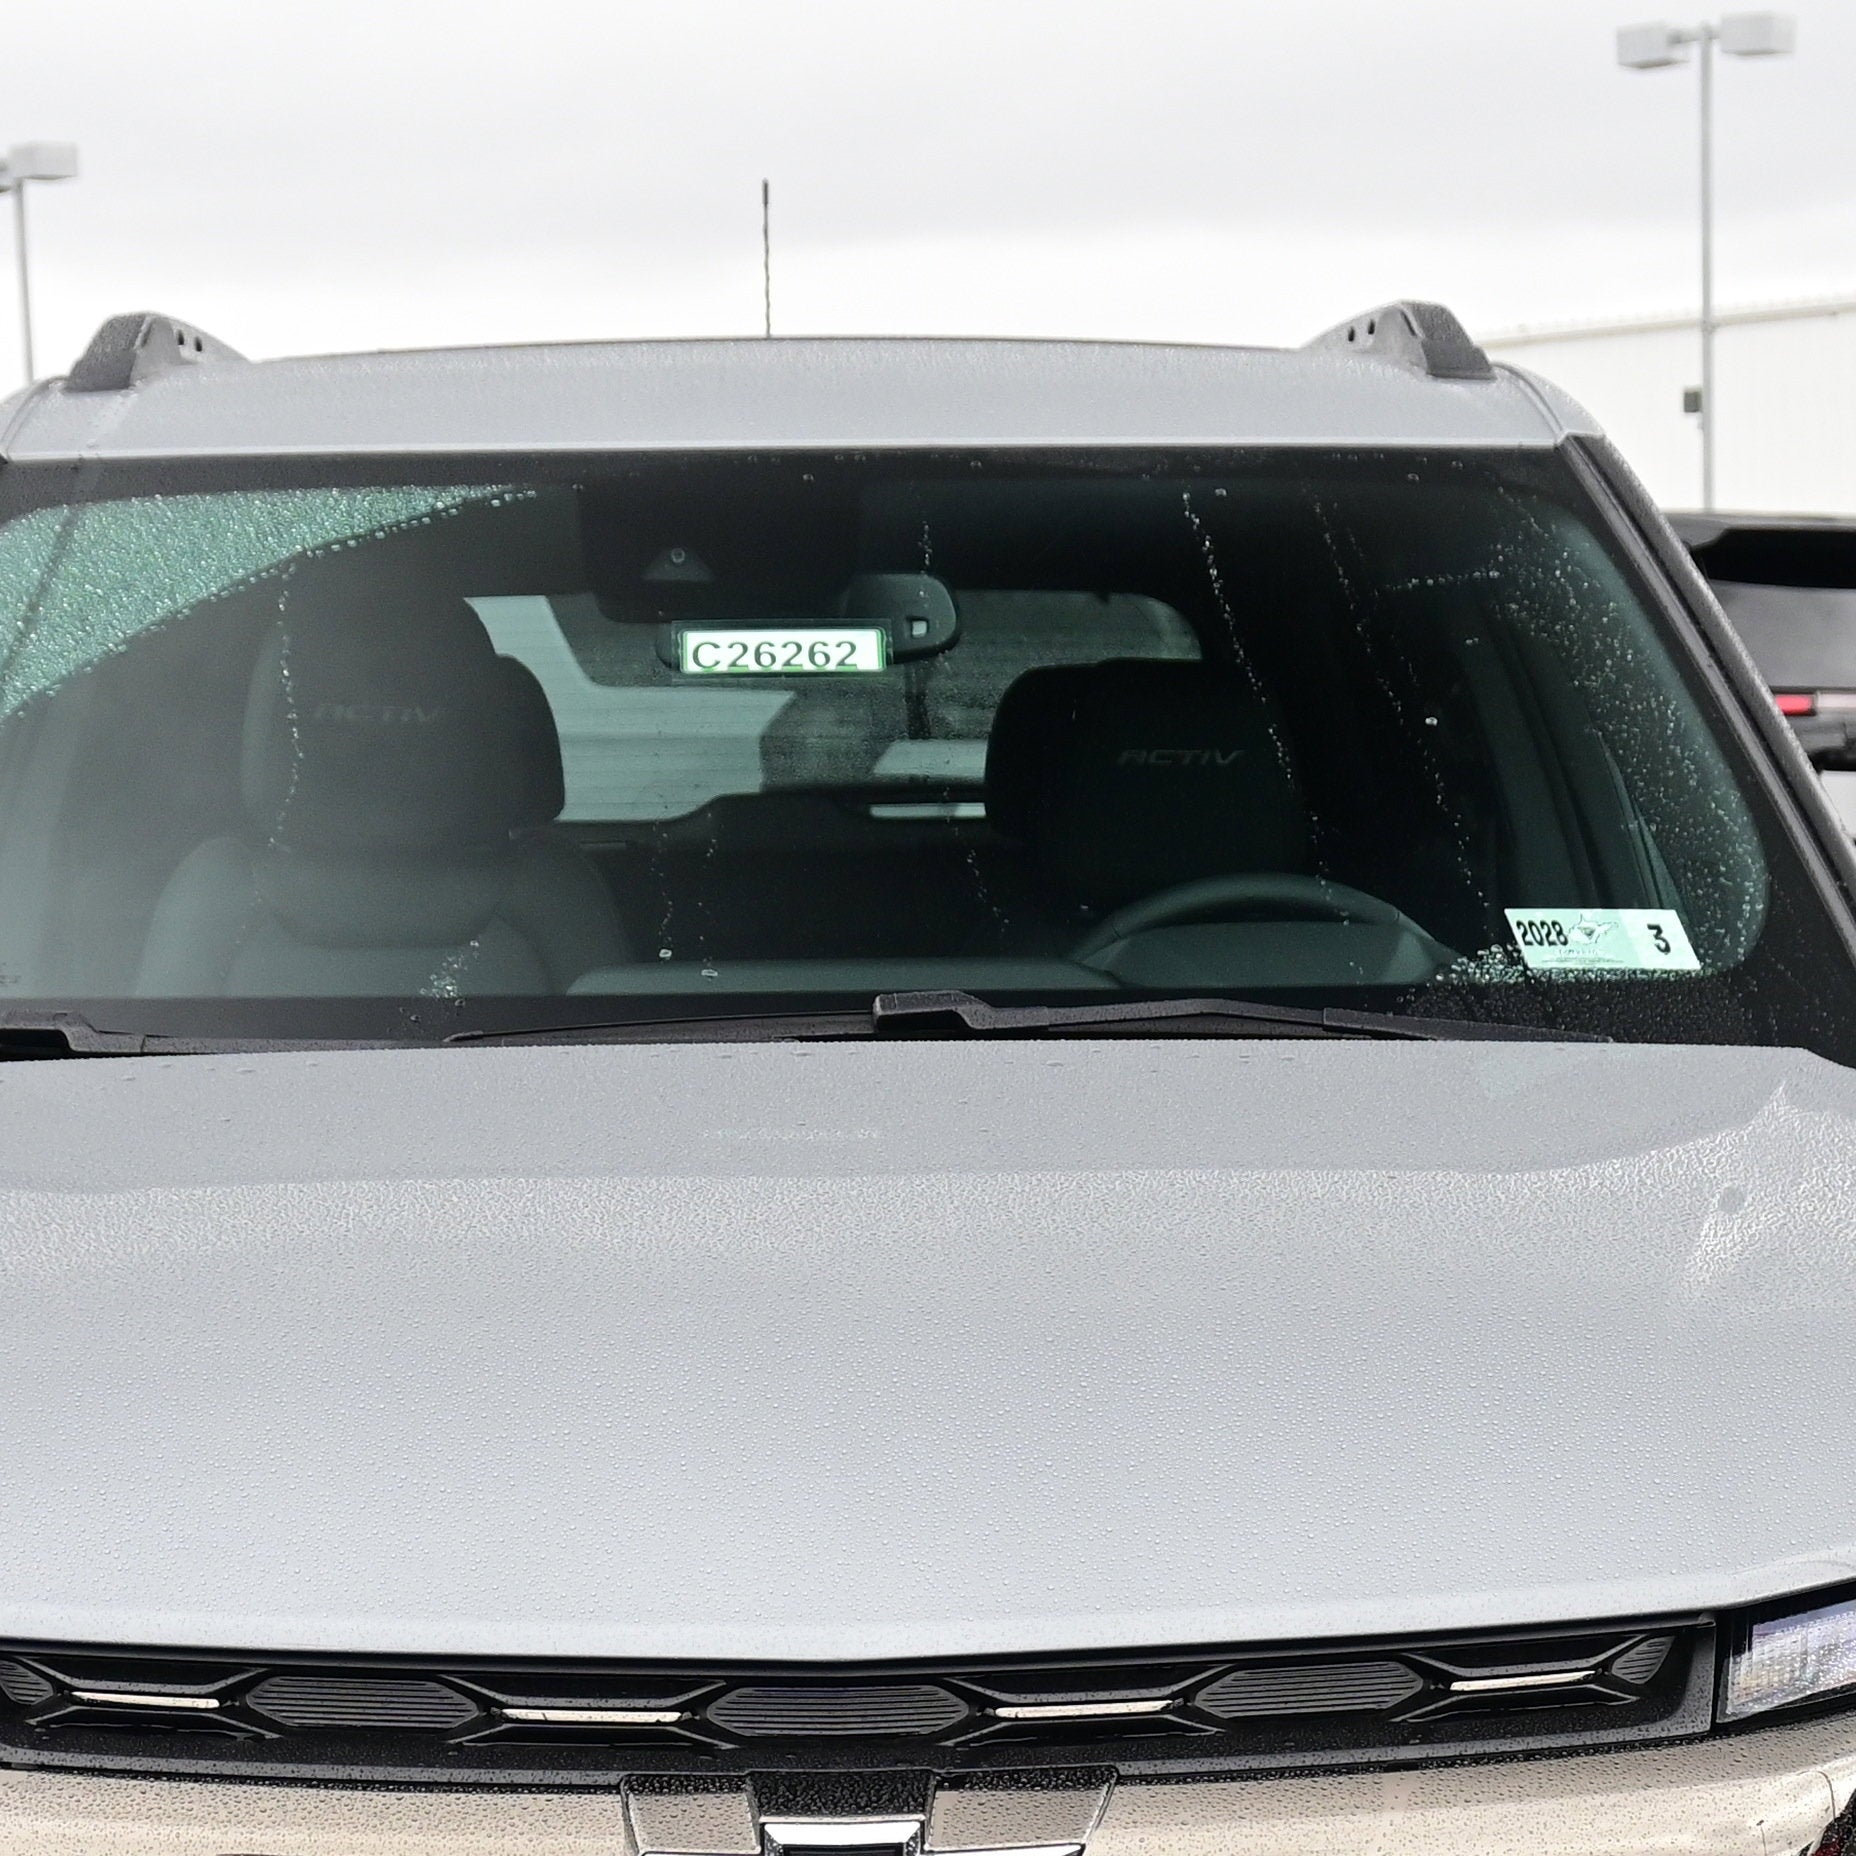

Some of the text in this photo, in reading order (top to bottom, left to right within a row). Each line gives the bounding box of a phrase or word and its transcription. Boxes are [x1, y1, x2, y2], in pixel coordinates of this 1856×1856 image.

[692, 640, 858, 669] C26262
[1117, 749, 1245, 766] ACTIV
[1516, 920, 1671, 956] 2028 3
